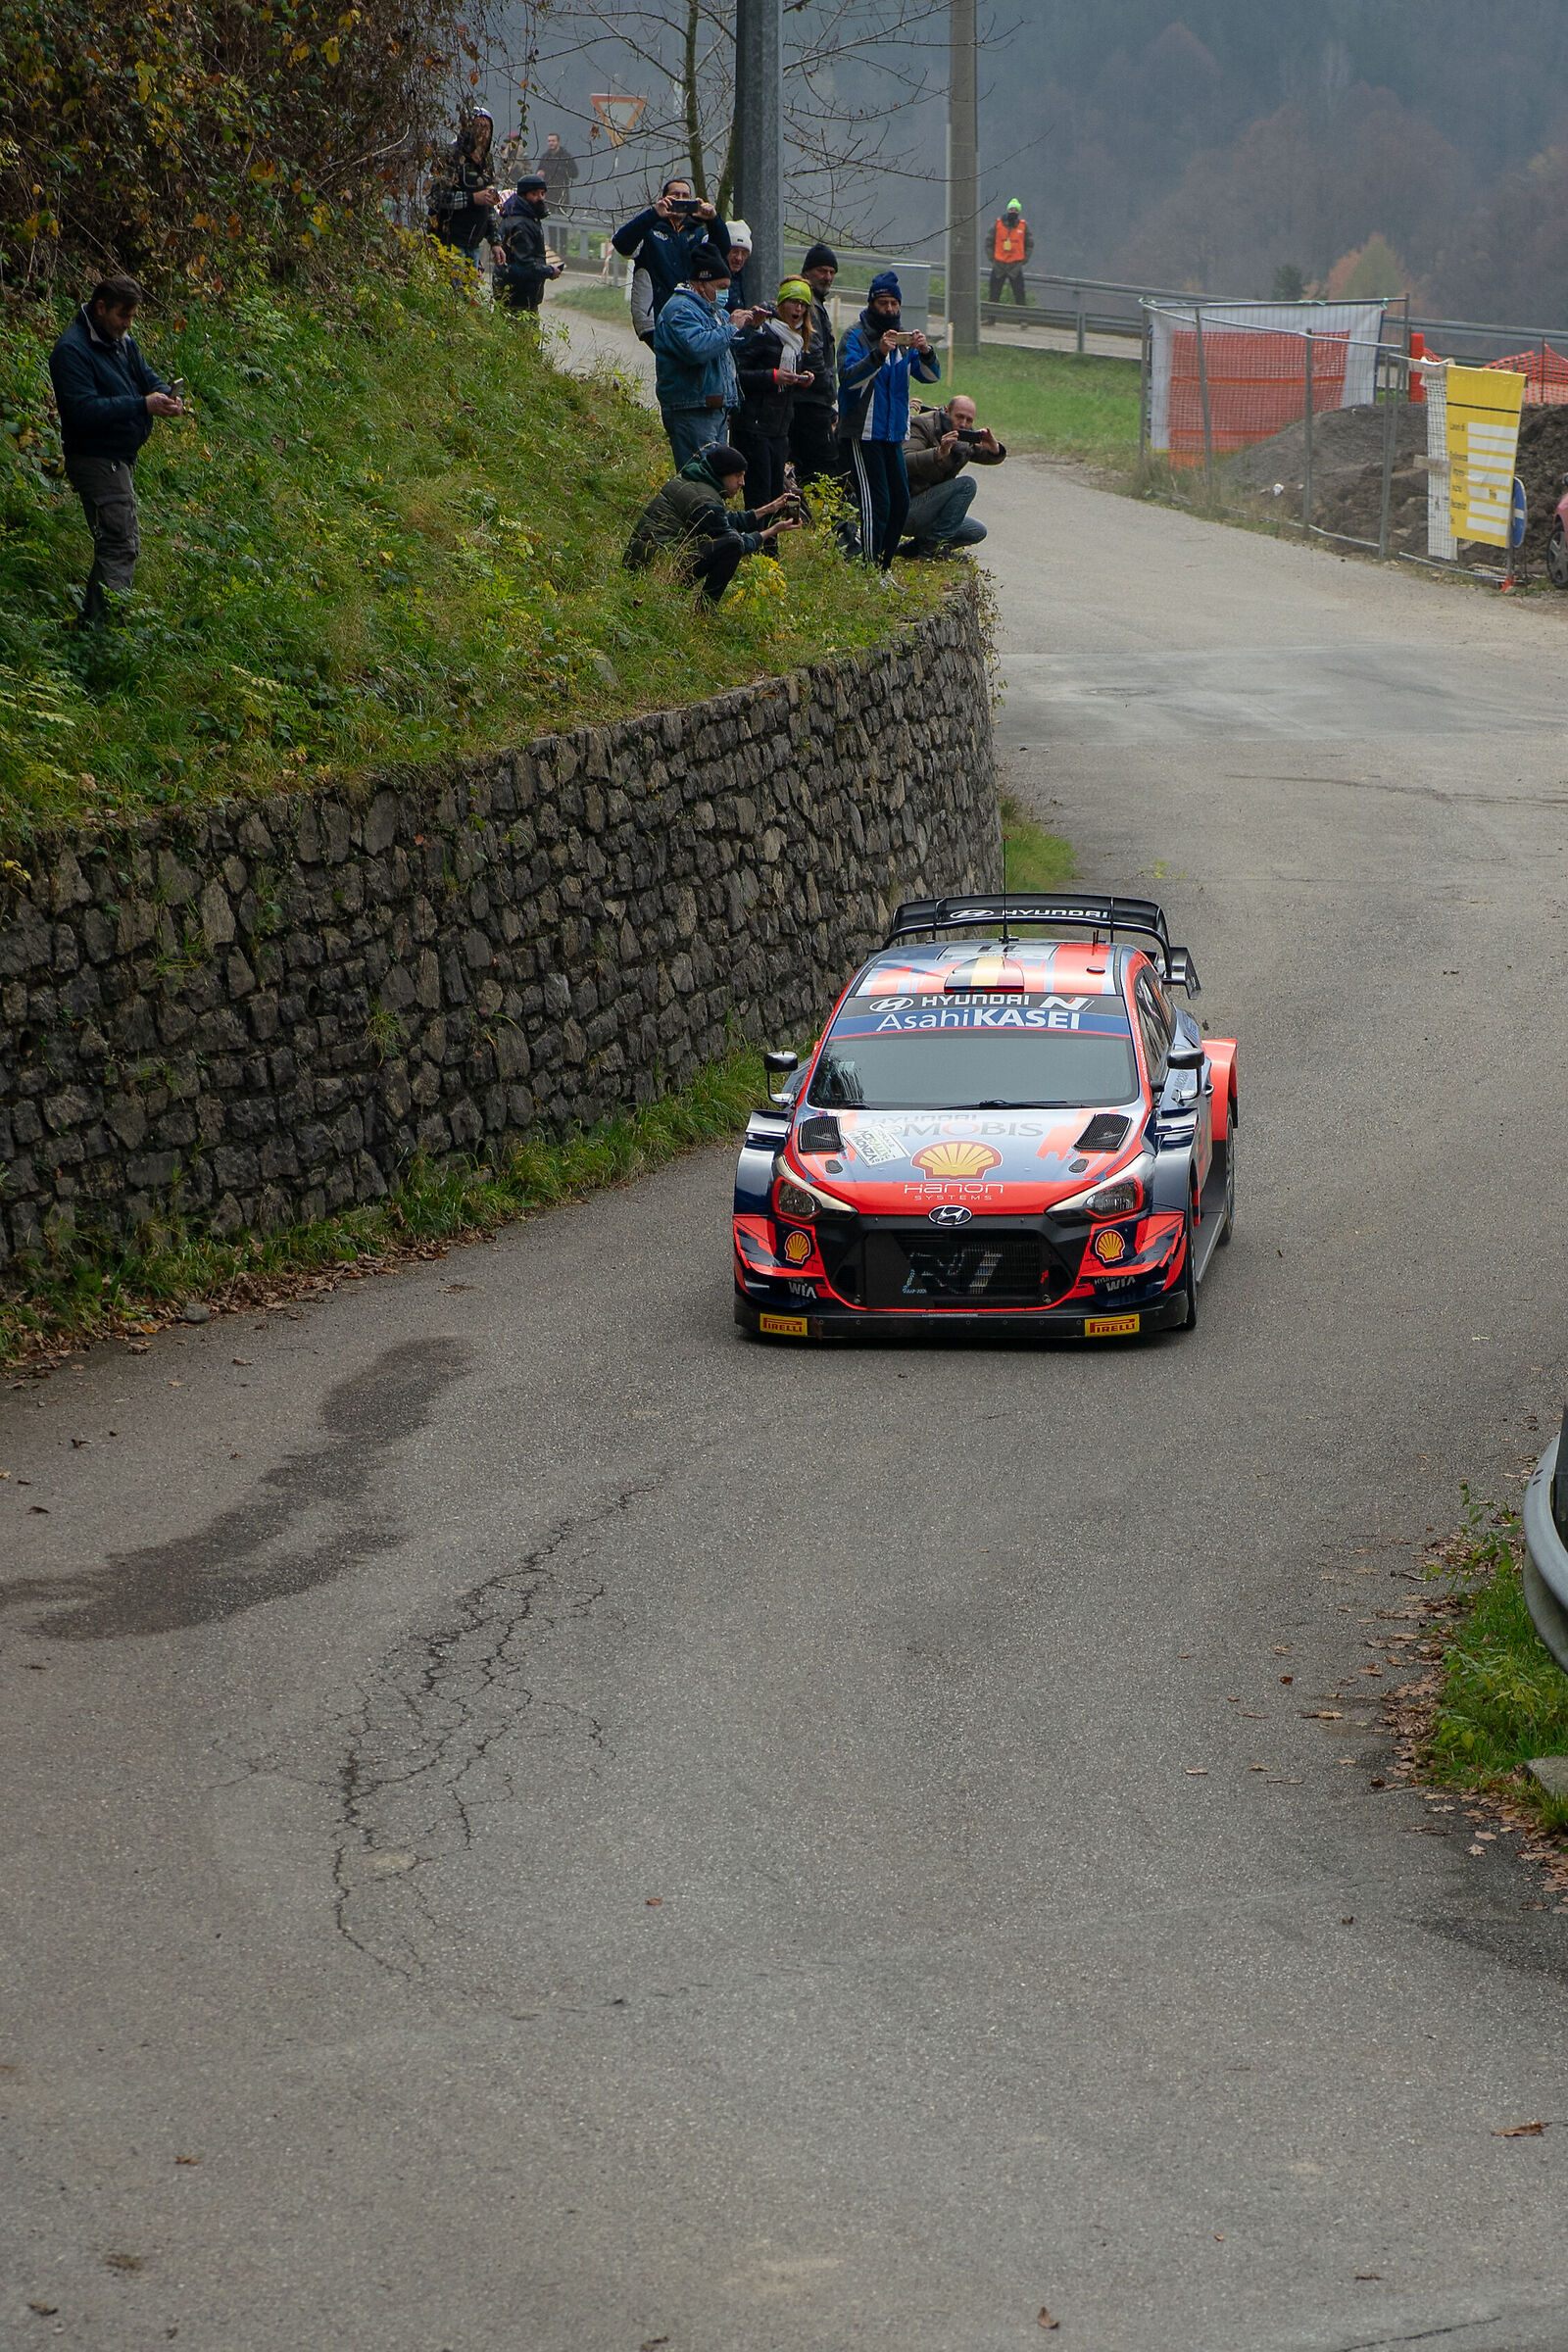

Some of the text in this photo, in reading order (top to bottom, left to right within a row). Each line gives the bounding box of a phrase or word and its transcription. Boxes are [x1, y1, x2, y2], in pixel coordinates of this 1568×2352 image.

[1003, 908, 1107, 918] HYUNDAI
[921, 994, 1030, 1007] HYUNDAI
[902, 1122, 1044, 1138] MOBIS
[762, 1316, 804, 1333] PIRELLI
[1089, 1318, 1136, 1334] PIRELLI
